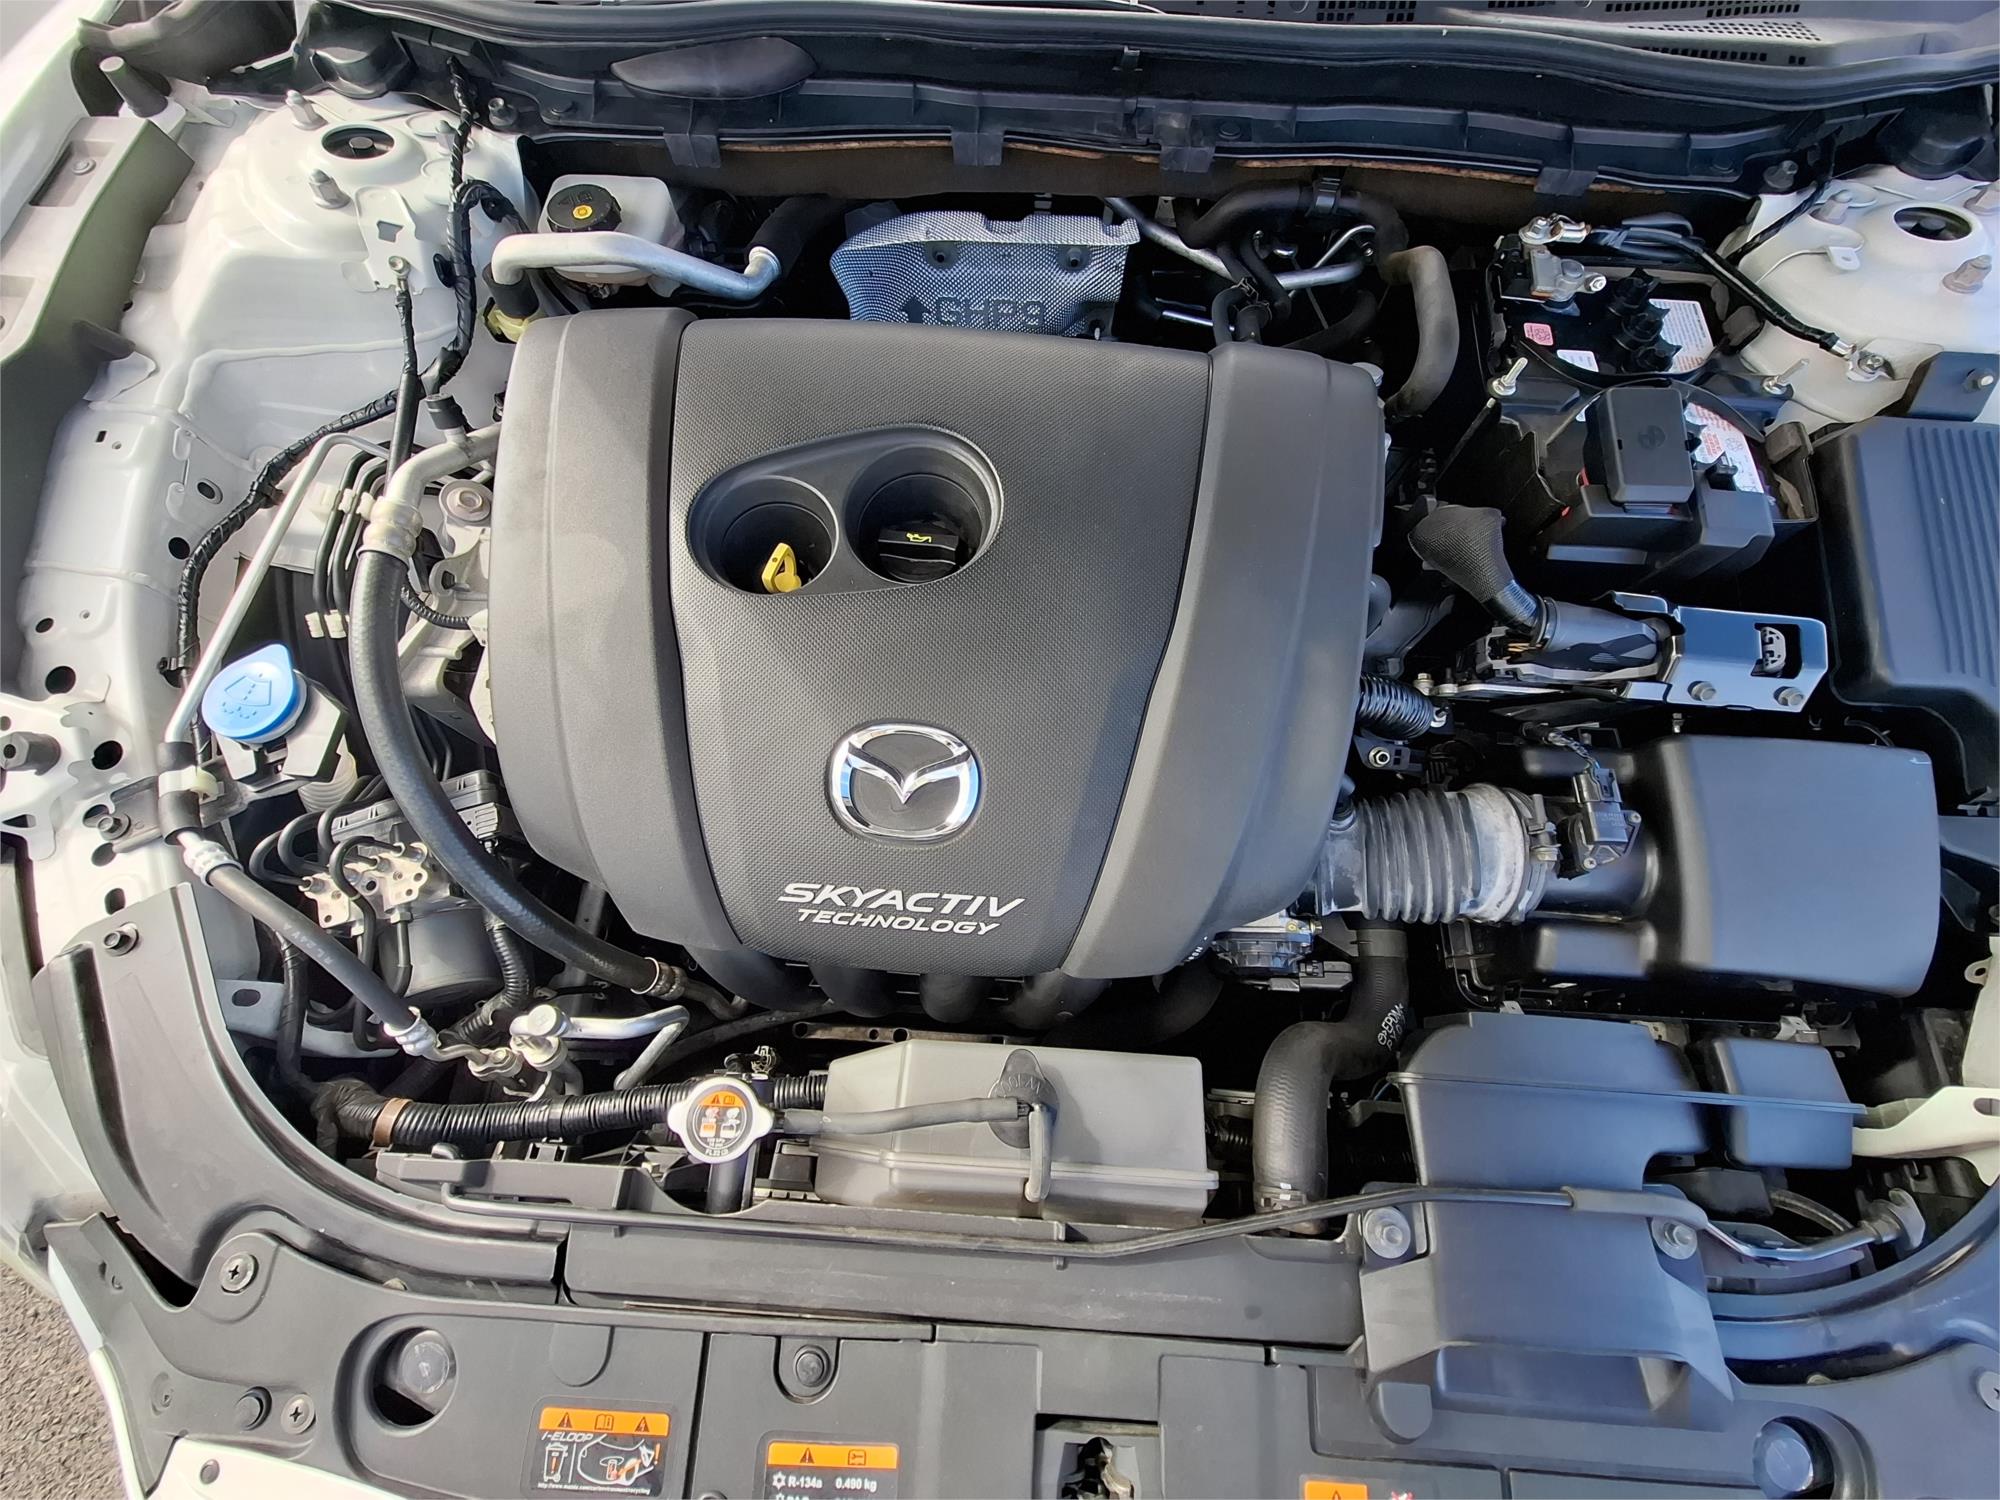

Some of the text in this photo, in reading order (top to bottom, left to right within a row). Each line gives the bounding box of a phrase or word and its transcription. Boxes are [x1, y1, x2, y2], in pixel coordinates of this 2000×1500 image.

[777, 883, 1026, 918] SKYACTIV
[797, 908, 1001, 936] TECHNOLOGY
[787, 1474, 878, 1493] R-134a 0.490 kg
